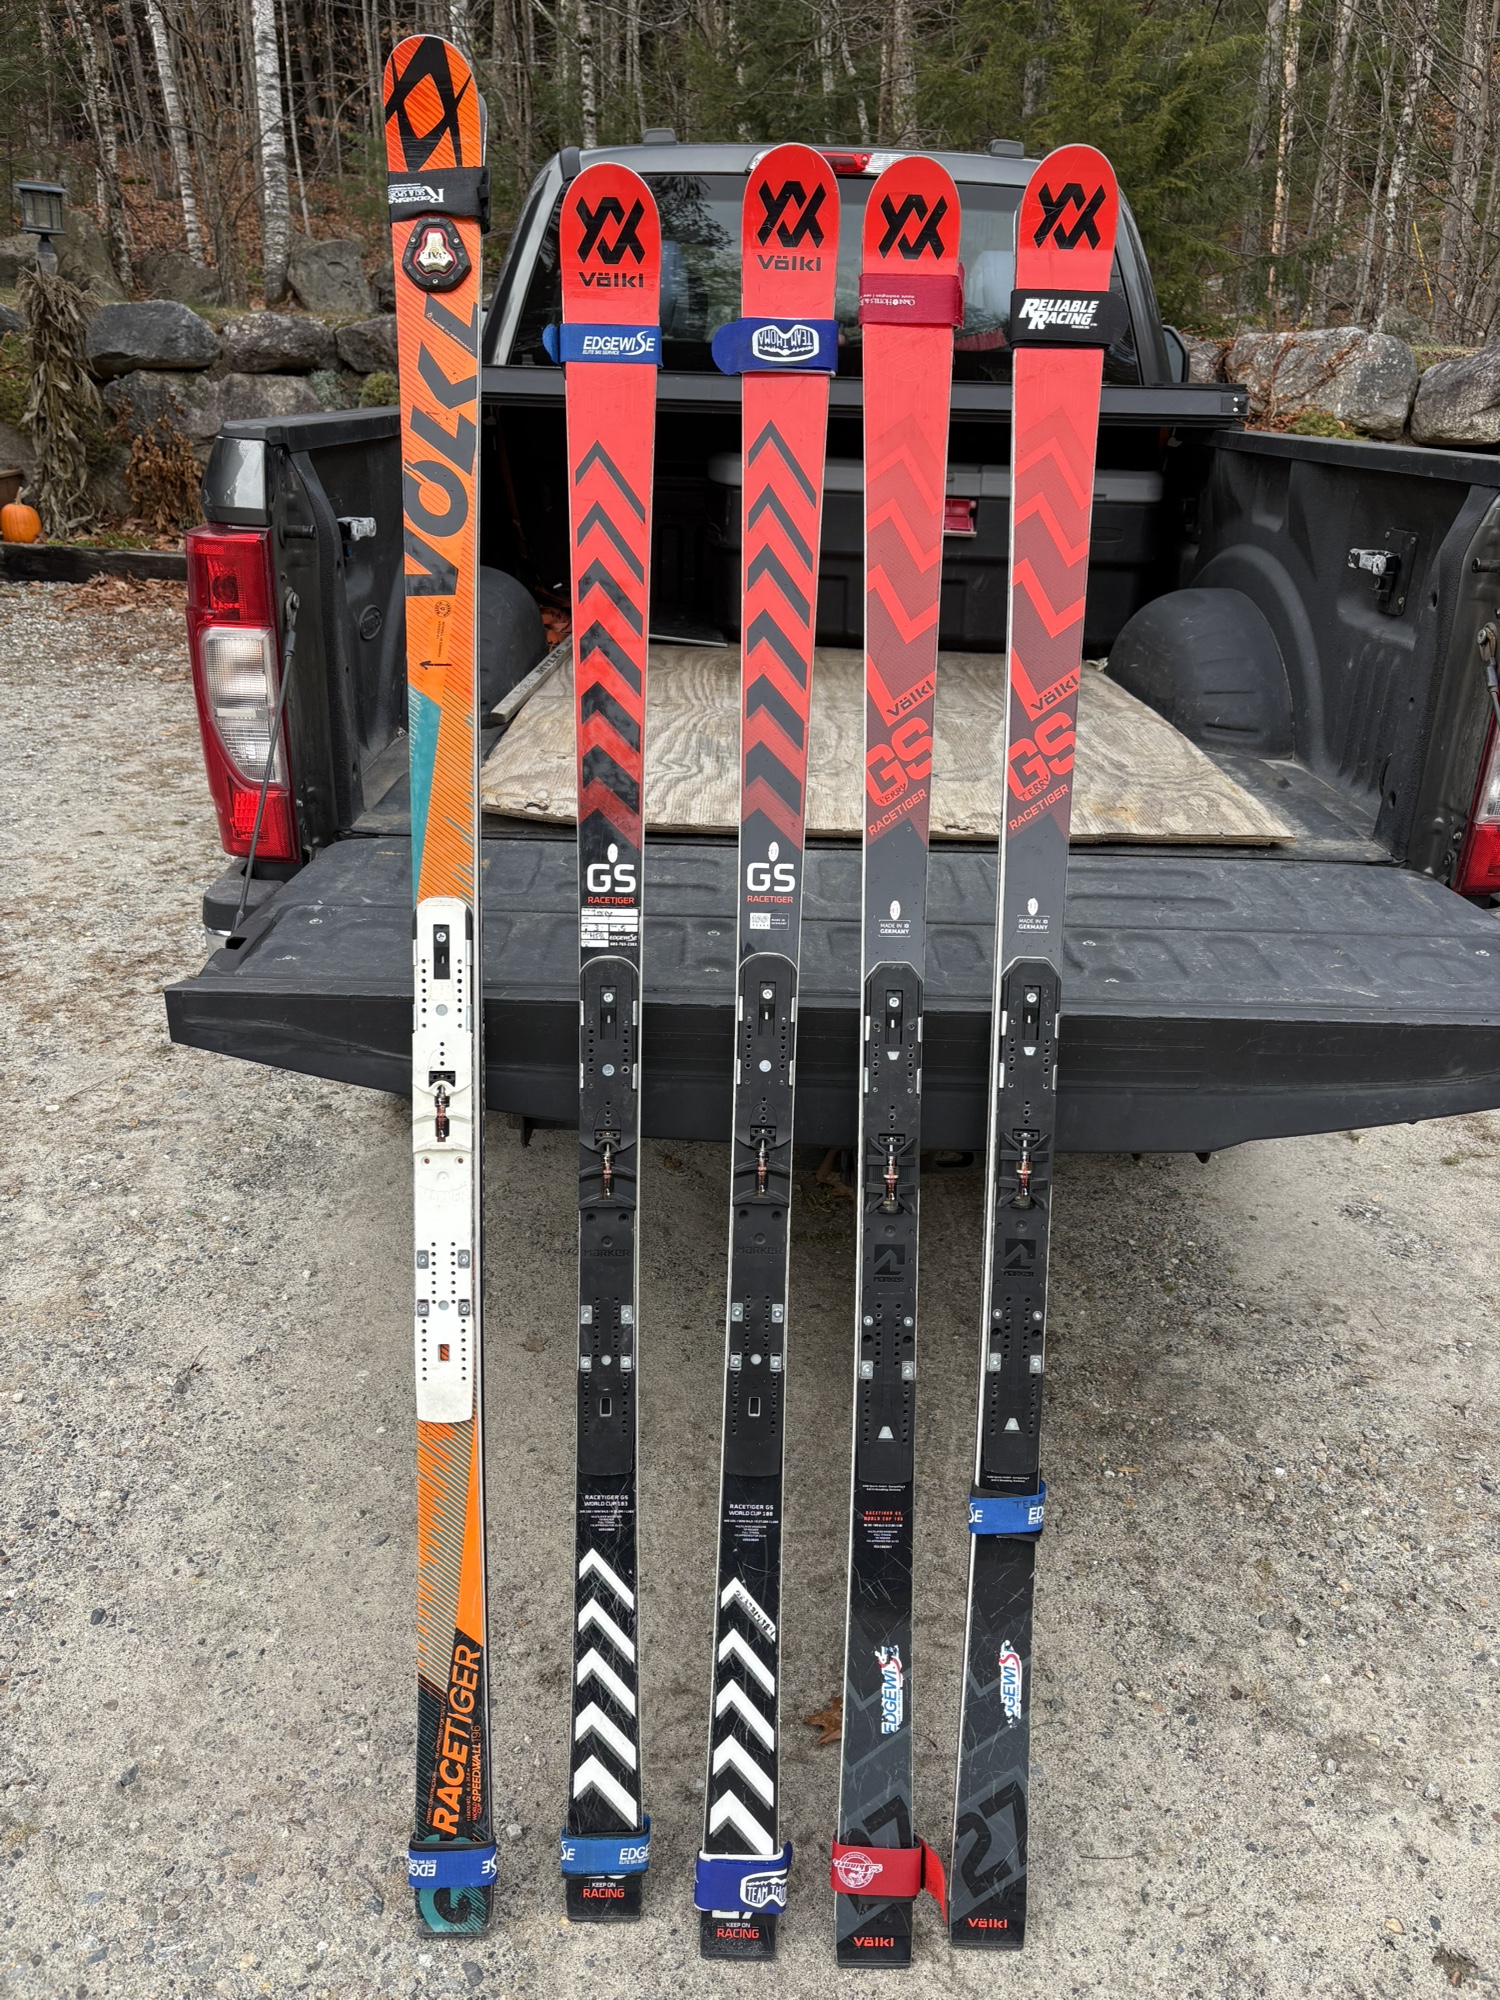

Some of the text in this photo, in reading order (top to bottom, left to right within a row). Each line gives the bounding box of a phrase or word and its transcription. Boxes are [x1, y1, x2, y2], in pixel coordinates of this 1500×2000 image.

[757, 255, 822, 272] Völkl
[578, 272, 644, 288] Völkl
[1018, 298, 1100, 318] RELIABLE
[1027, 310, 1094, 330] RACING
[582, 330, 656, 355] EDGEWISE
[758, 328, 813, 349] TEAM THOMA
[886, 680, 934, 717] Völkl
[1030, 675, 1079, 712] Völkl
[866, 716, 934, 807] GS
[1007, 711, 1077, 802] GS
[876, 782, 907, 806] TERRY
[1018, 774, 1050, 802] TERRY
[867, 788, 928, 836] RACETIGER
[1008, 784, 1070, 831] RACETIGER
[586, 863, 637, 893] GS
[746, 862, 796, 893] GS
[587, 896, 635, 905] RACETIGER
[746, 895, 794, 904] RACETIGER
[432, 1644, 481, 1836] RACETIGER
[471, 1725, 482, 1802] SPEEDWALL 196
[953, 1780, 1028, 1899] 27
[582, 1888, 625, 1898] RACING
[747, 1886, 769, 1904] TEAM
[716, 1928, 760, 1939] RACING
[967, 1917, 1008, 1929] Völkl
[853, 1937, 895, 1948] Völkl
